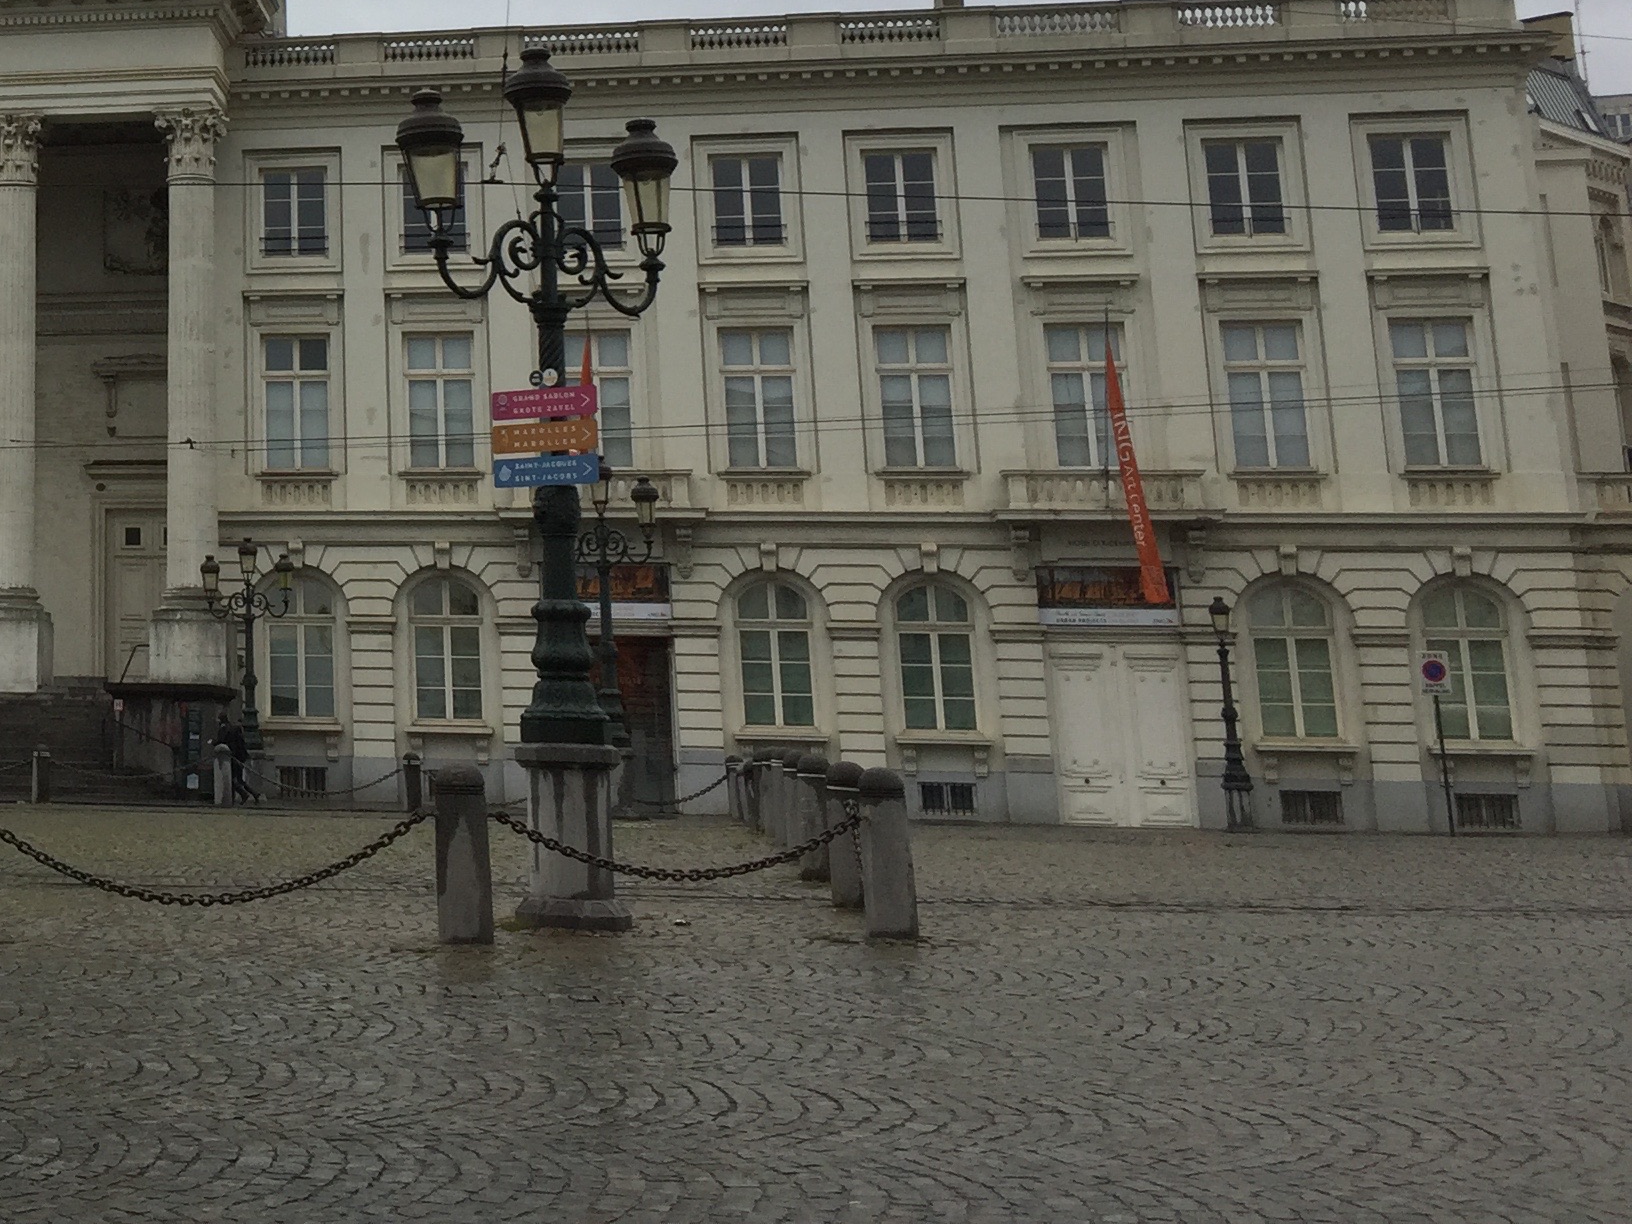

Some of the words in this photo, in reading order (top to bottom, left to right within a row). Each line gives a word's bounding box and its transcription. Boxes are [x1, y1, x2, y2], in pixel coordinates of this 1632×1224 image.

[513, 393, 540, 402] GRAND
[543, 391, 576, 400] SABLON
[513, 405, 542, 414] GROTE
[546, 403, 576, 412] ZAVEL
[514, 425, 576, 435] MAROLLES
[514, 438, 576, 447] MAROLLEN
[515, 460, 577, 470] SAINT-JACQUES
[515, 472, 578, 482] SINT-JACOBS
[1123, 465, 1137, 491] Art
[1129, 493, 1147, 548] Center
